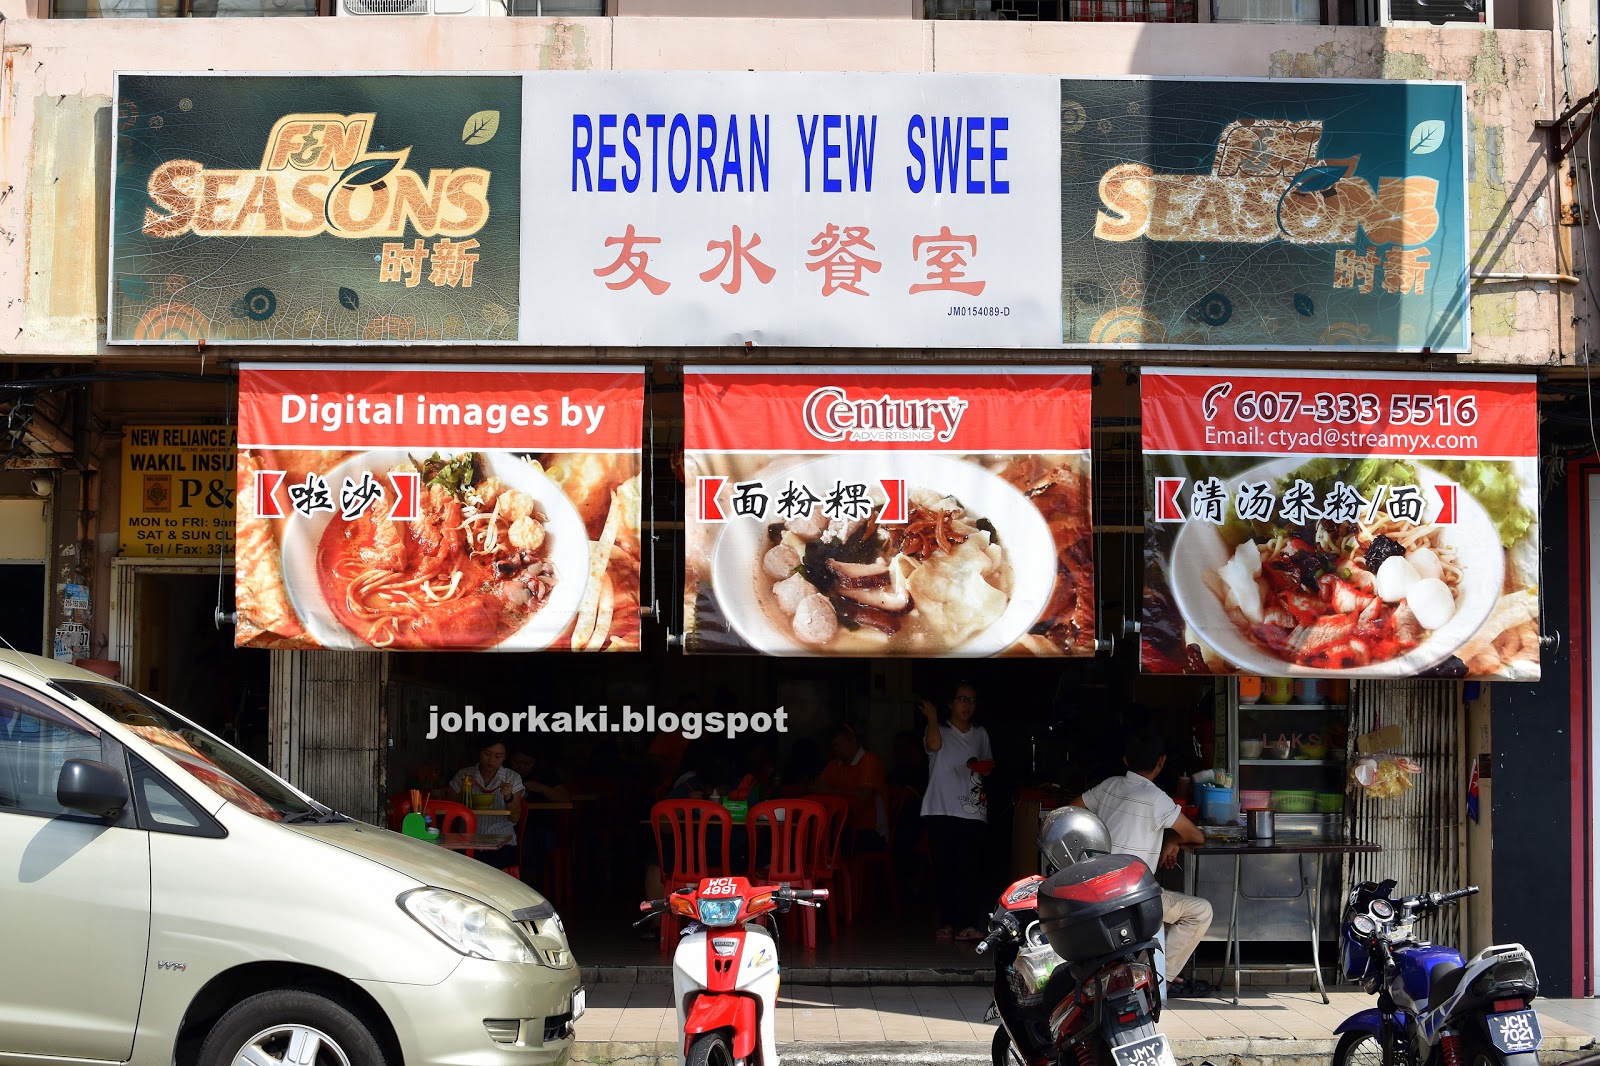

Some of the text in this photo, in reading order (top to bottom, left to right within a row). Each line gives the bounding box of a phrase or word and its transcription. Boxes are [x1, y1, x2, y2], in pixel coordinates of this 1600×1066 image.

[265, 115, 371, 171] F&N
[571, 113, 1010, 195] RESTORAN YEW SWEE
[143, 158, 491, 239] SEASONS
[379, 238, 481, 287] 时新
[593, 222, 987, 297] 友水餐室
[946, 306, 1011, 317] JM0154089-D
[281, 394, 606, 434] Digital images by
[805, 388, 967, 441] Century
[1234, 391, 1479, 426] 607-333 5516
[131, 430, 159, 446] NEW
[163, 429, 226, 446] RELIANCE
[851, 431, 933, 440] ADVERTISING
[1205, 426, 1479, 452] Email: ctyad@streamyx.com
[130, 454, 237, 472] WAKIL INSU
[290, 475, 382, 516] 啦沙
[732, 480, 872, 519] 面粉粿
[129, 518, 160, 527] MON
[165, 518, 178, 527] to
[182, 518, 208, 527] FRI:
[137, 531, 236, 540] SAT & SUN CL
[145, 544, 164, 554] Tel
[175, 544, 202, 554] Fax:
[702, 887, 736, 895] 4991
[709, 879, 737, 887] WCL
[1500, 1014, 1529, 1030] JCH
[1500, 1026, 1534, 1042] 7021
[1128, 1043, 1157, 1063] JMY
